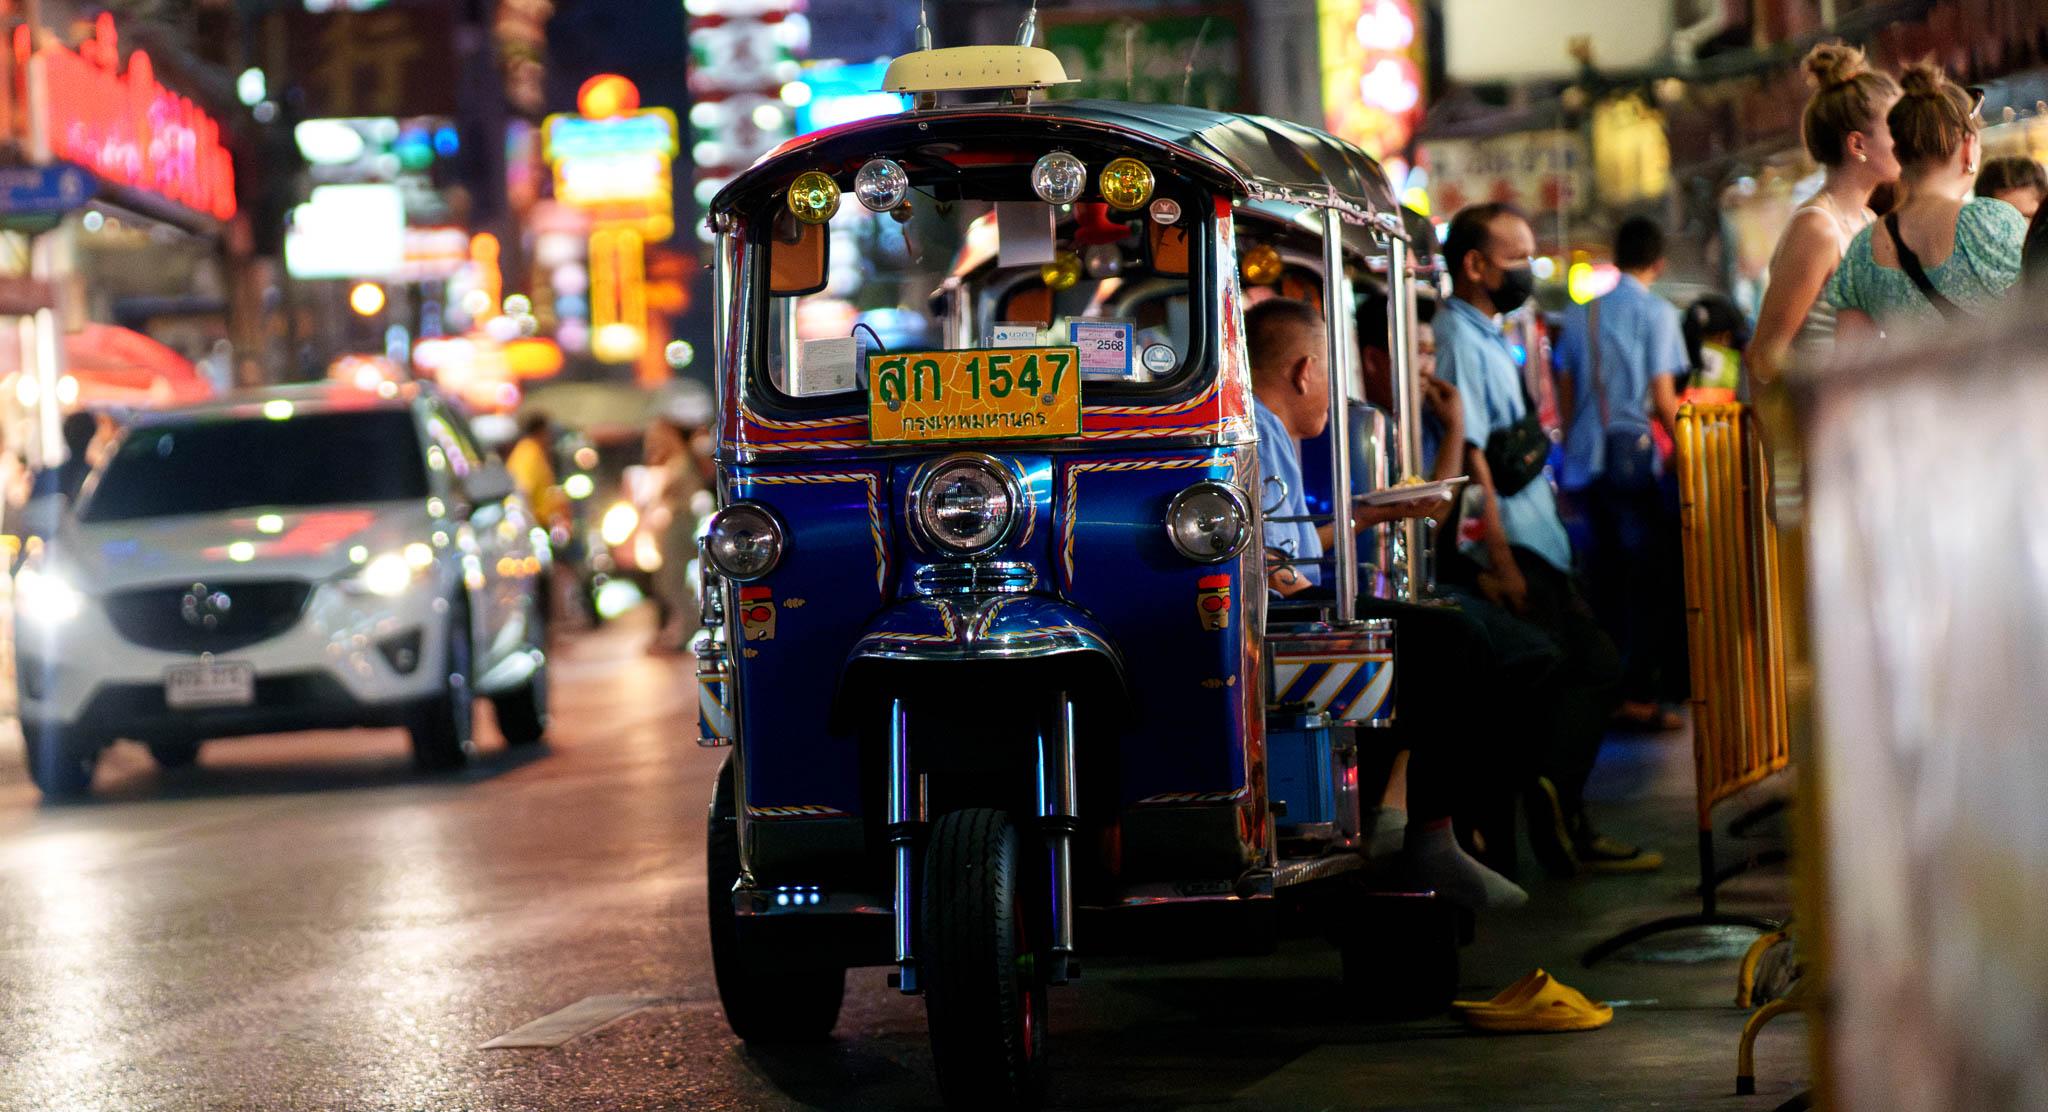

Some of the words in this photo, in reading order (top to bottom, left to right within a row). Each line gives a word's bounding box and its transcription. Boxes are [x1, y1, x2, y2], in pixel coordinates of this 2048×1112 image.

[1097, 340, 1124, 351] 2568
[878, 356, 942, 402] สก
[966, 354, 1070, 400] 1547
[902, 411, 1047, 436] กรุงเทพมหานคร
